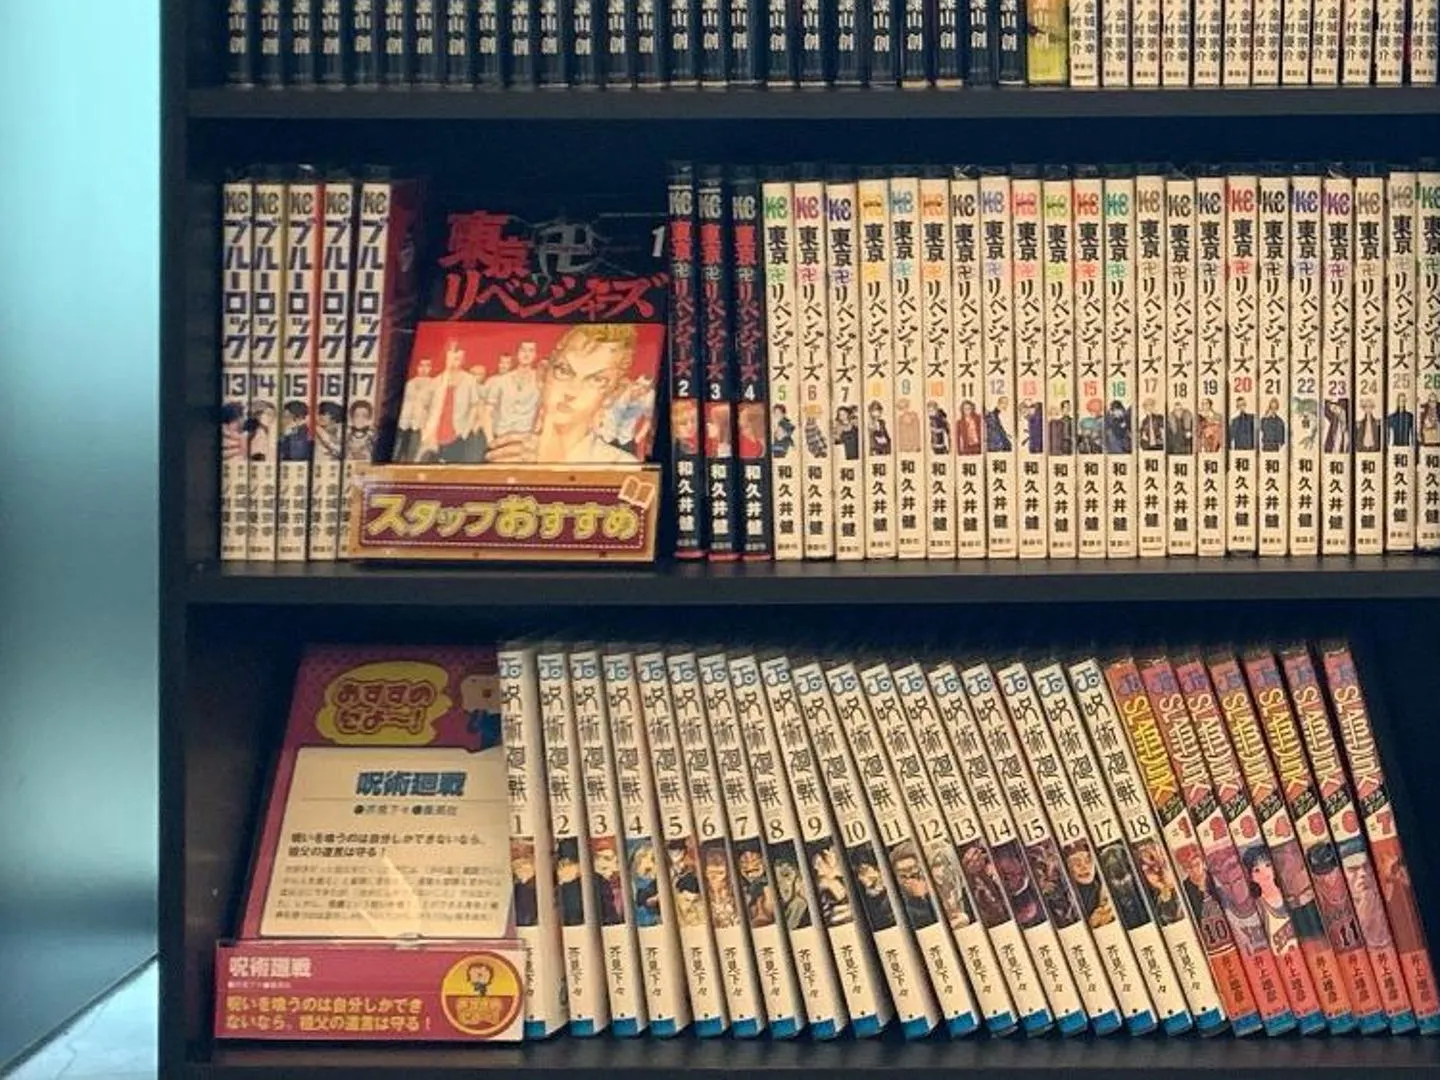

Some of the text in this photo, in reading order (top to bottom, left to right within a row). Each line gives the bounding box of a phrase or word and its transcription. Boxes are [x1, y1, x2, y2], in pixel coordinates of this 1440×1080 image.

[652, 226, 666, 257] 1
[225, 216, 252, 359] ブルーロック
[286, 217, 314, 359] ブルーロック
[955, 224, 979, 377] 東京卍リベンジャーズ
[1170, 224, 1193, 377] 東京卍リベンジャーズ
[1329, 222, 1350, 376] 東京卍リベンジャーズ
[225, 374, 246, 396] 13
[285, 374, 307, 396] 15
[678, 381, 689, 396] 2
[744, 385, 755, 400] 4
[961, 383, 973, 397] 11
[1174, 383, 1187, 397] 18
[1329, 380, 1346, 395] 23
[366, 494, 639, 540] スタッフおすすめ
[677, 461, 694, 531] 和久井健
[745, 465, 763, 535] 和久井健
[962, 463, 977, 531] 和久井健
[1174, 463, 1188, 531] 和久井健
[1329, 461, 1344, 529] 和久井健
[543, 686, 571, 802] 呪術廻戦
[676, 687, 714, 804] 呪術廻戦
[738, 688, 782, 809] 呪術廻戦
[876, 696, 934, 811] 呪術廻戦
[1084, 695, 1140, 806] 呪術廻戦
[356, 771, 467, 797] 呪術廻戦
[557, 815, 570, 835] 2
[702, 816, 715, 836] 6
[769, 818, 784, 839] 8
[919, 820, 944, 840] 12
[1128, 815, 1151, 838] 18
[228, 956, 313, 978] 呪術廻戦
